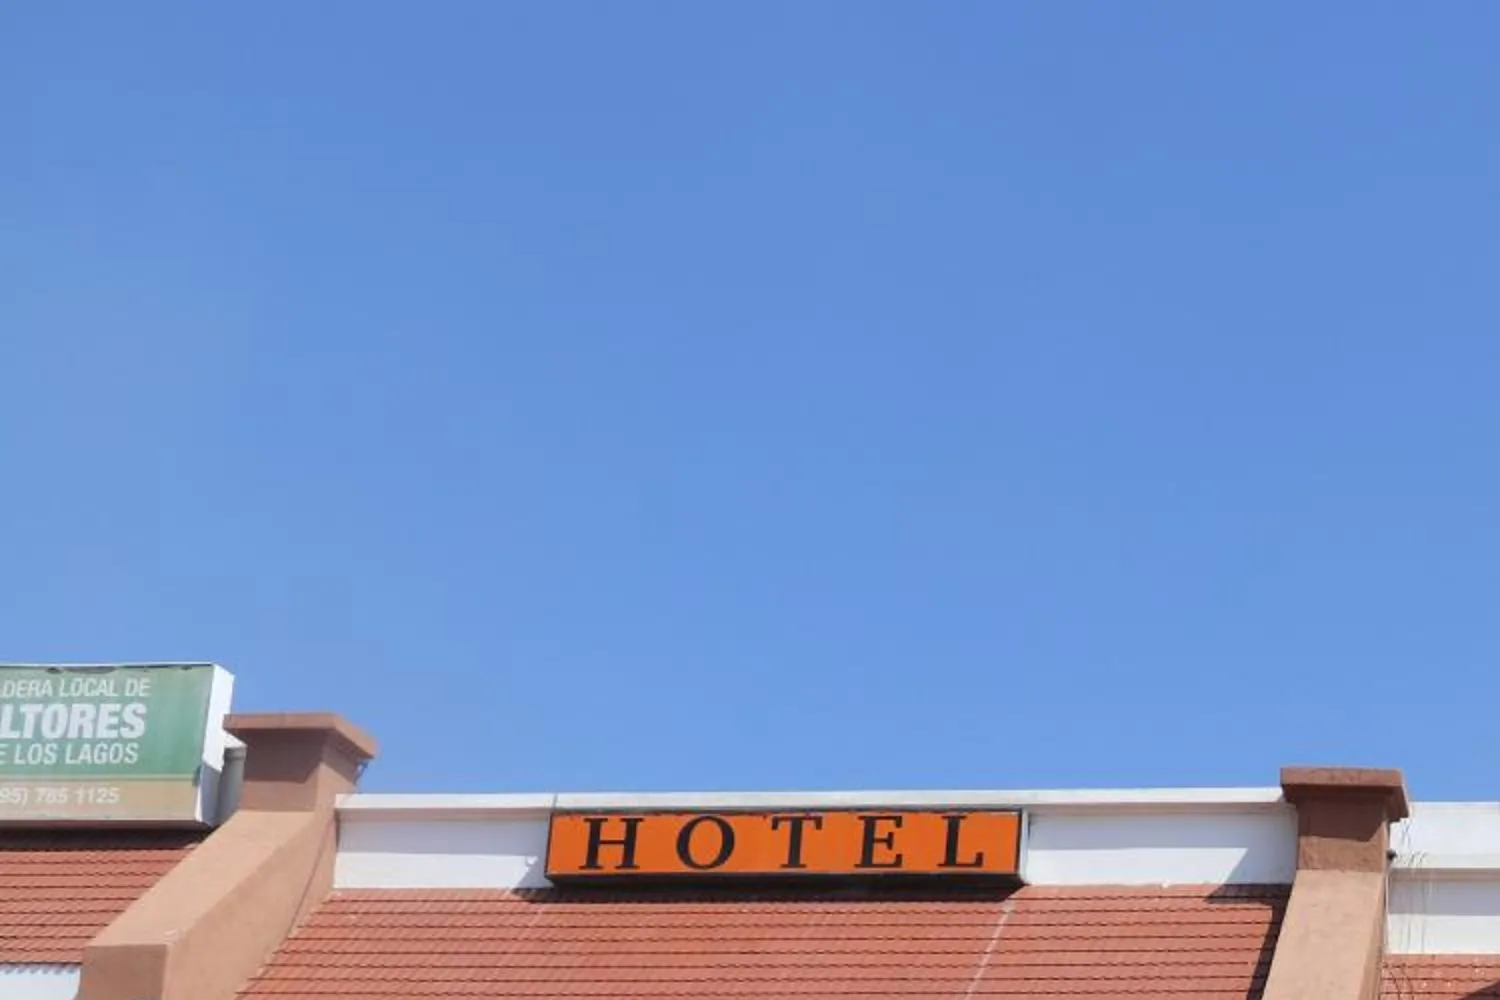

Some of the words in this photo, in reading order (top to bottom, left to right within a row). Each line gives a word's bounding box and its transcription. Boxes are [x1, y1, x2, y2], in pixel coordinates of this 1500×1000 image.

[59, 677, 119, 697] LOCAL
[124, 677, 152, 697] DE
[0, 702, 147, 739] LTORES
[14, 743, 58, 765] LOS
[65, 742, 140, 765] LAGOS
[35, 787, 69, 804] 785
[75, 786, 121, 804] 1125
[578, 815, 984, 870] HOTEL
